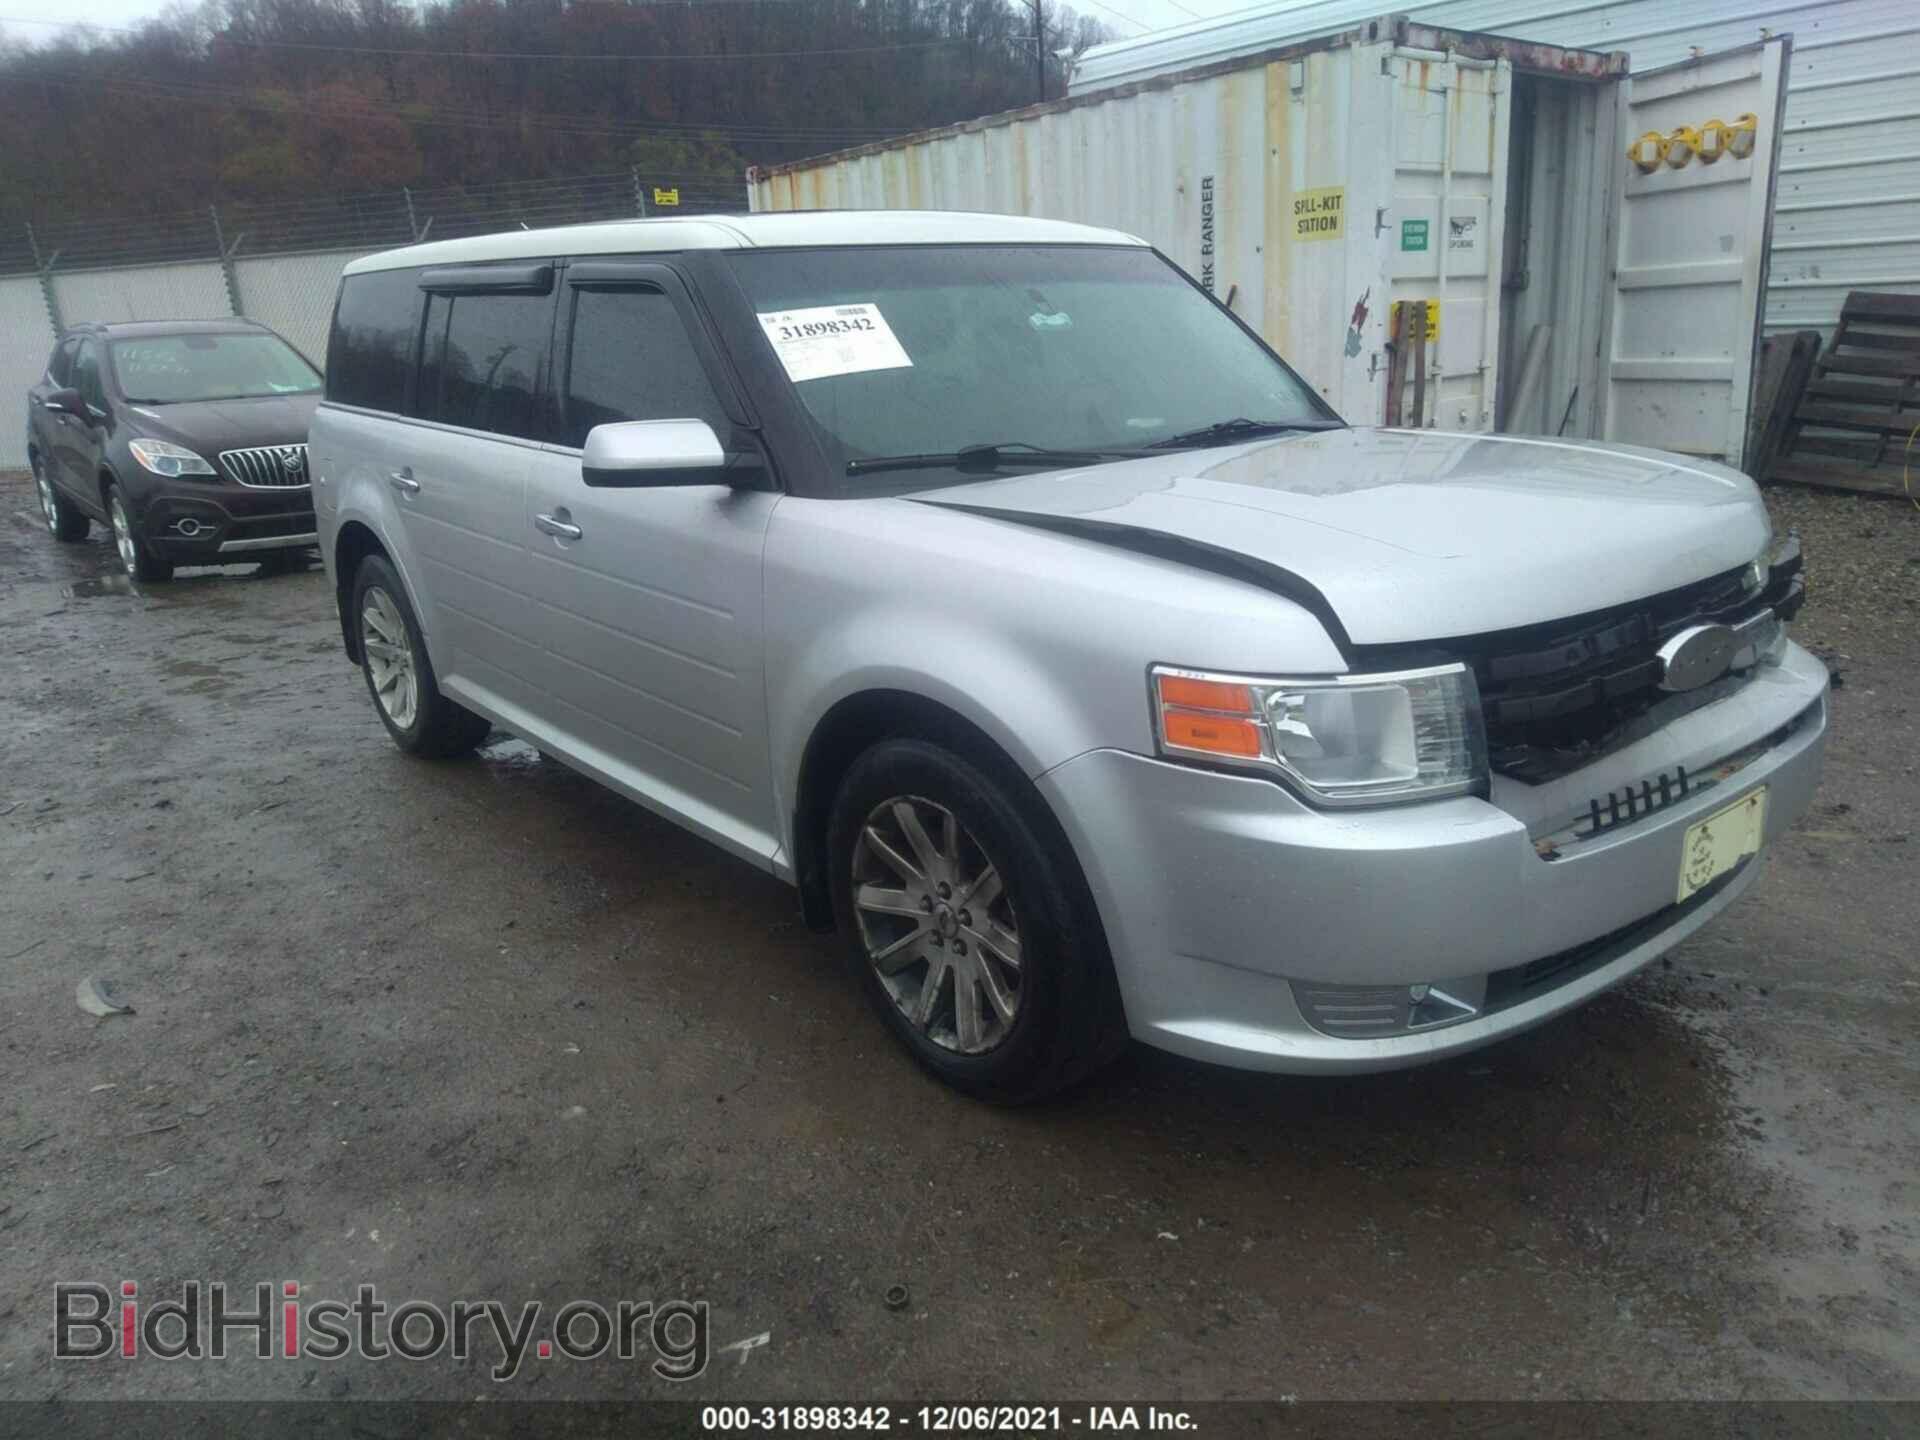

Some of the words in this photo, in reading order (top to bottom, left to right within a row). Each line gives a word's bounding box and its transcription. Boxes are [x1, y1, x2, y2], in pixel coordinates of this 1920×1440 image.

[1201, 176, 1214, 256] RANGER
[1202, 263, 1214, 295] RK
[778, 317, 876, 341] 31898342
